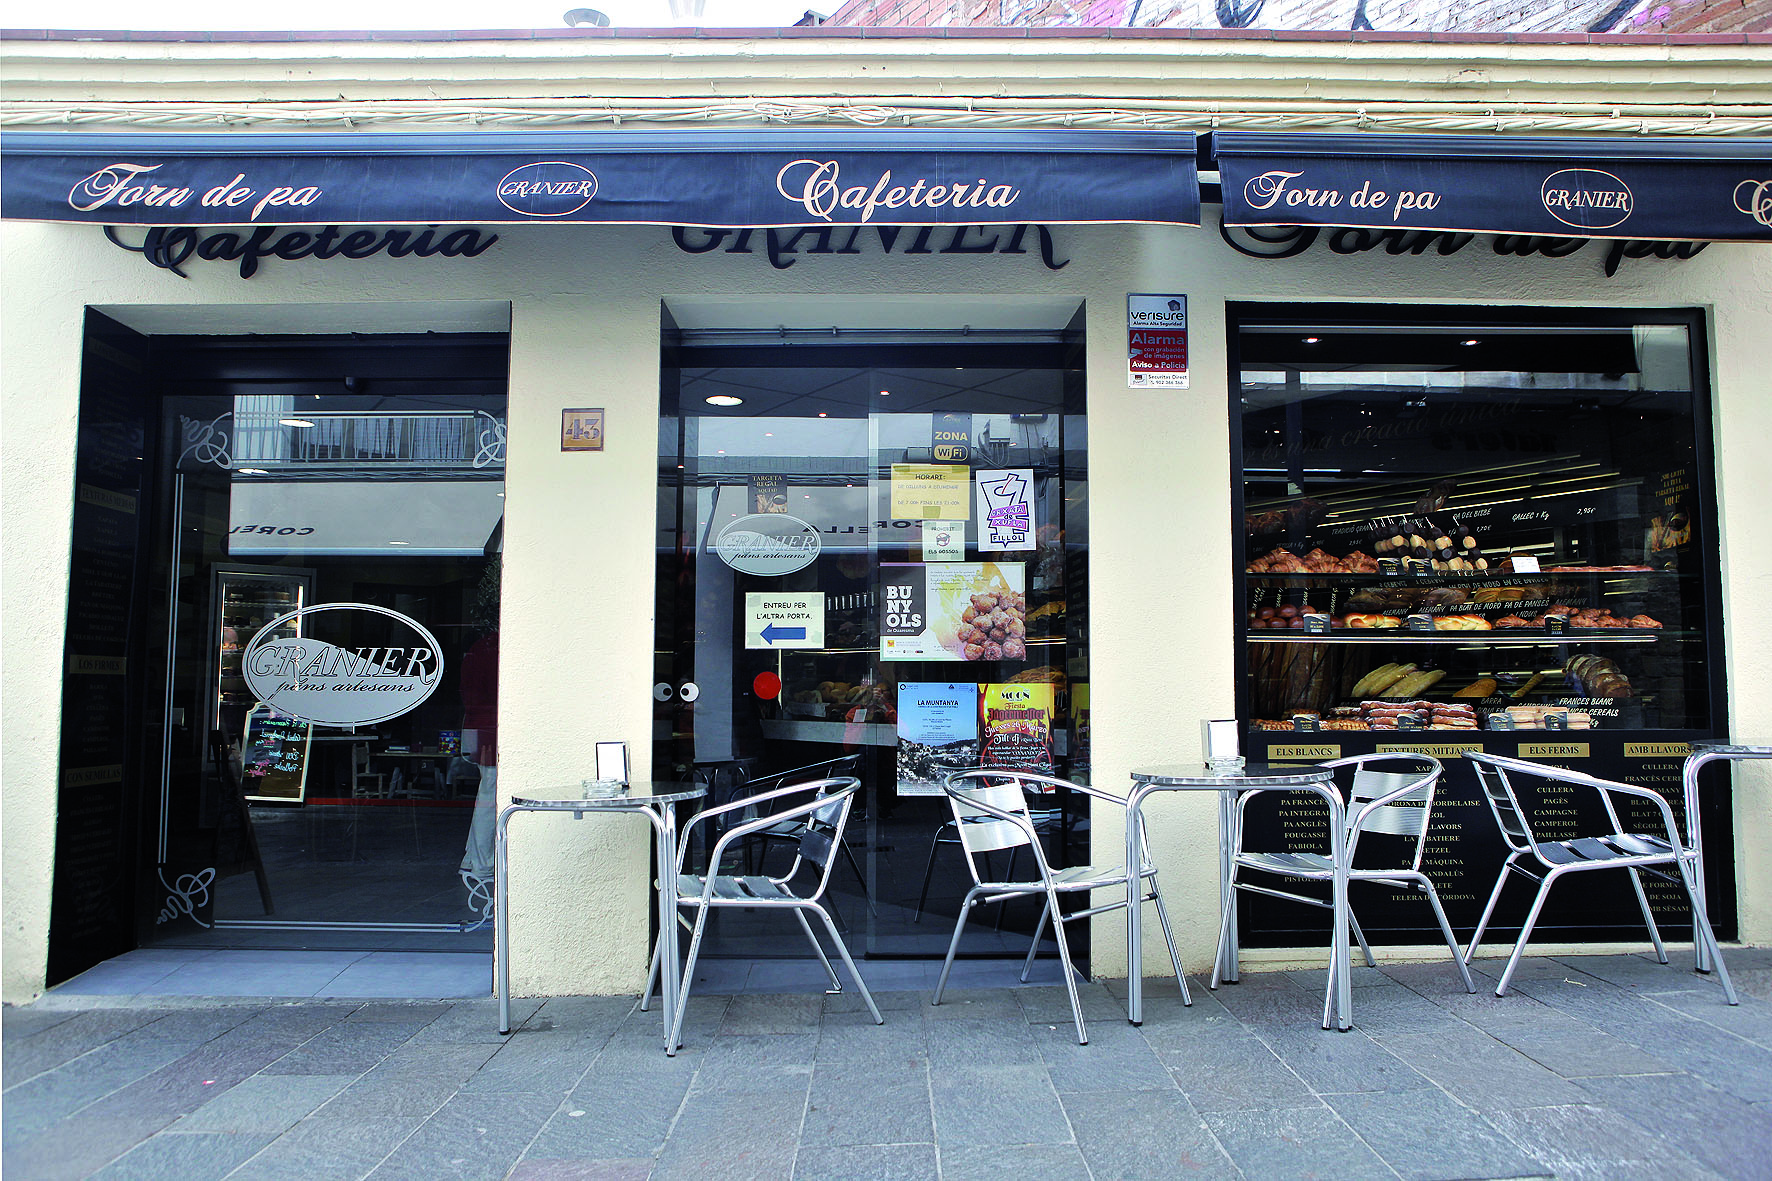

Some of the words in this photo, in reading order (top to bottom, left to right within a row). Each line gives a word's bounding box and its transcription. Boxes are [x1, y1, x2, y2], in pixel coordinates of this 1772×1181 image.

[68, 162, 196, 212] Torn
[201, 173, 254, 208] de
[252, 185, 323, 221] pa
[500, 177, 594, 200] GRANIER
[776, 158, 1021, 223] Cafeteria
[1243, 170, 1343, 212] Torn
[1349, 180, 1390, 210] de
[1392, 188, 1442, 222] pa
[1545, 188, 1630, 212] GRANIER
[1130, 311, 1184, 321] verisure
[1131, 333, 1185, 345] Alarma
[1154, 352, 1185, 360] imágenes
[1131, 361, 1153, 369] Aviso
[566, 418, 600, 440] 43
[934, 431, 968, 441] ZONA
[938, 447, 962, 458] WiFi
[719, 535, 815, 554] GRANIER
[728, 552, 761, 565] pans
[762, 551, 806, 560] artesans
[886, 585, 913, 600] BU
[763, 602, 792, 610] ENTREU
[794, 601, 807, 610] PER
[886, 599, 913, 614] NY
[1473, 603, 1482, 611] DE
[1514, 601, 1523, 609] DE
[756, 612, 785, 620] L'ALTRA
[787, 612, 813, 620] PORTA.
[886, 613, 922, 628] OLS
[249, 645, 435, 686] GRANIER
[267, 680, 328, 701] pans
[331, 679, 415, 693] artesans
[1005, 702, 1026, 711] Fiesta
[985, 723, 1011, 738] Jueves
[1021, 720, 1048, 734] Marzo
[1276, 748, 1294, 756] ELS
[1295, 747, 1334, 756] BLANCS
[1529, 746, 1547, 754] ELS
[1548, 746, 1580, 754] FERMS
[1628, 745, 1649, 754] AMB
[1650, 745, 1692, 754] LLAVORS
[1624, 774, 1660, 782] FRANCÈS
[1292, 797, 1329, 806] FRANCÈS
[1543, 796, 1569, 805] PAGÈS
[1294, 819, 1327, 828] ANGLÈS
[1632, 821, 1660, 829] SÈGOL
[1425, 857, 1464, 867] MÀQUINA
[1662, 904, 1689, 912] SÈSAM
